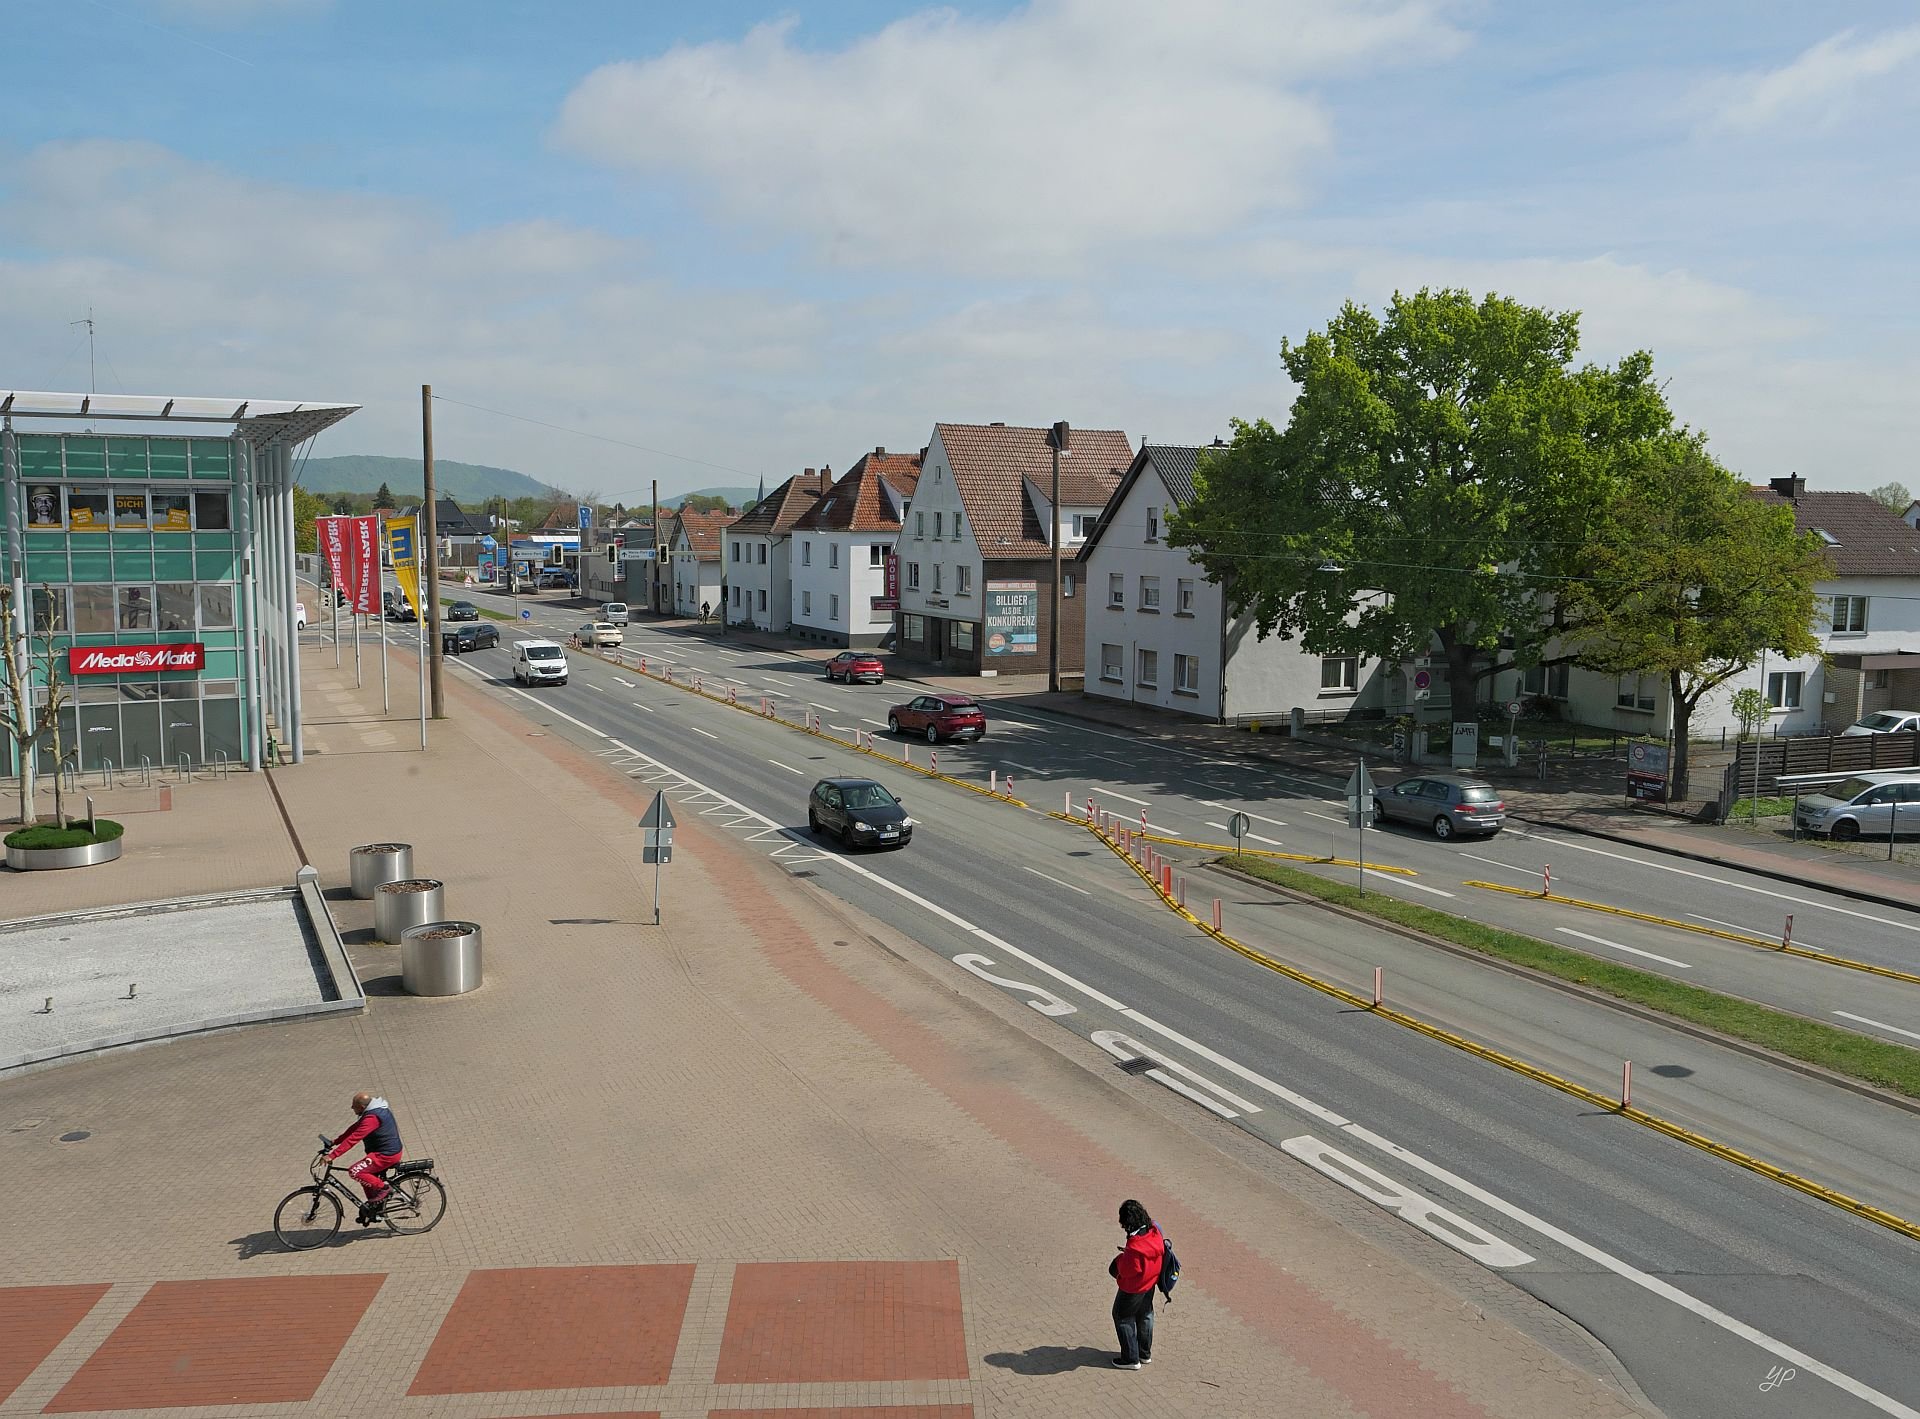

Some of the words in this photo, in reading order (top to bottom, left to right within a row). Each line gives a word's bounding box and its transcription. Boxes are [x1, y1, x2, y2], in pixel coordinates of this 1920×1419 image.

[116, 500, 144, 508] DICH!
[995, 595, 1028, 606] BILLIGER
[1001, 607, 1012, 615] ALS
[1012, 606, 1022, 615] DIE
[987, 615, 1036, 627] KONKURRENZ
[79, 652, 135, 669] Media
[149, 650, 197, 666] Markt
